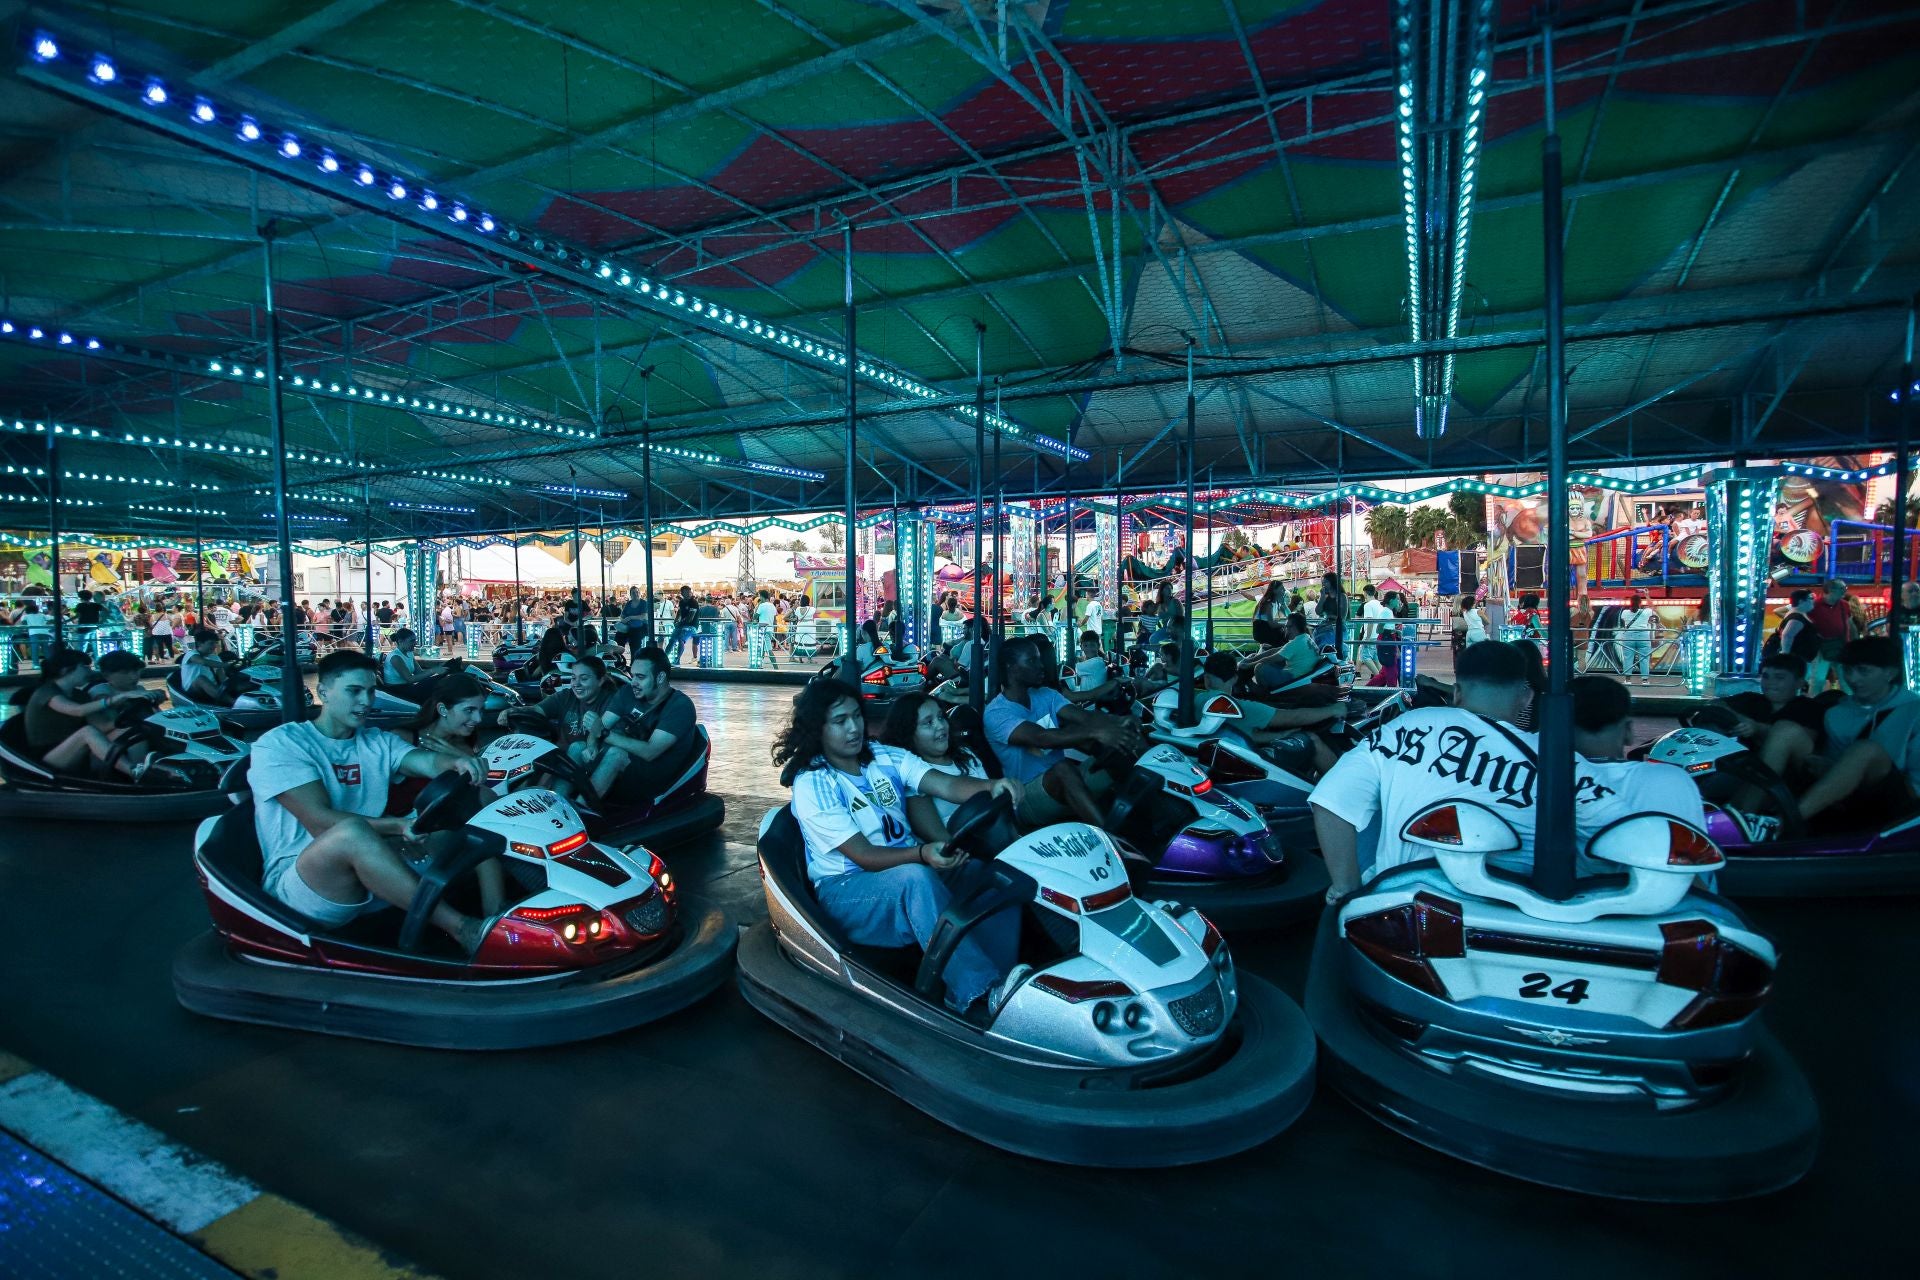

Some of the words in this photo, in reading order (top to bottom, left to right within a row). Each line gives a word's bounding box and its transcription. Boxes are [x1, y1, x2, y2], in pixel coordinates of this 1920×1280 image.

[496, 805, 526, 817] Auto
[551, 819, 563, 828] 3
[882, 814, 904, 842] 10
[1029, 842, 1062, 858] Auto
[1090, 867, 1108, 881] 10
[1519, 973, 1589, 1004] 24
